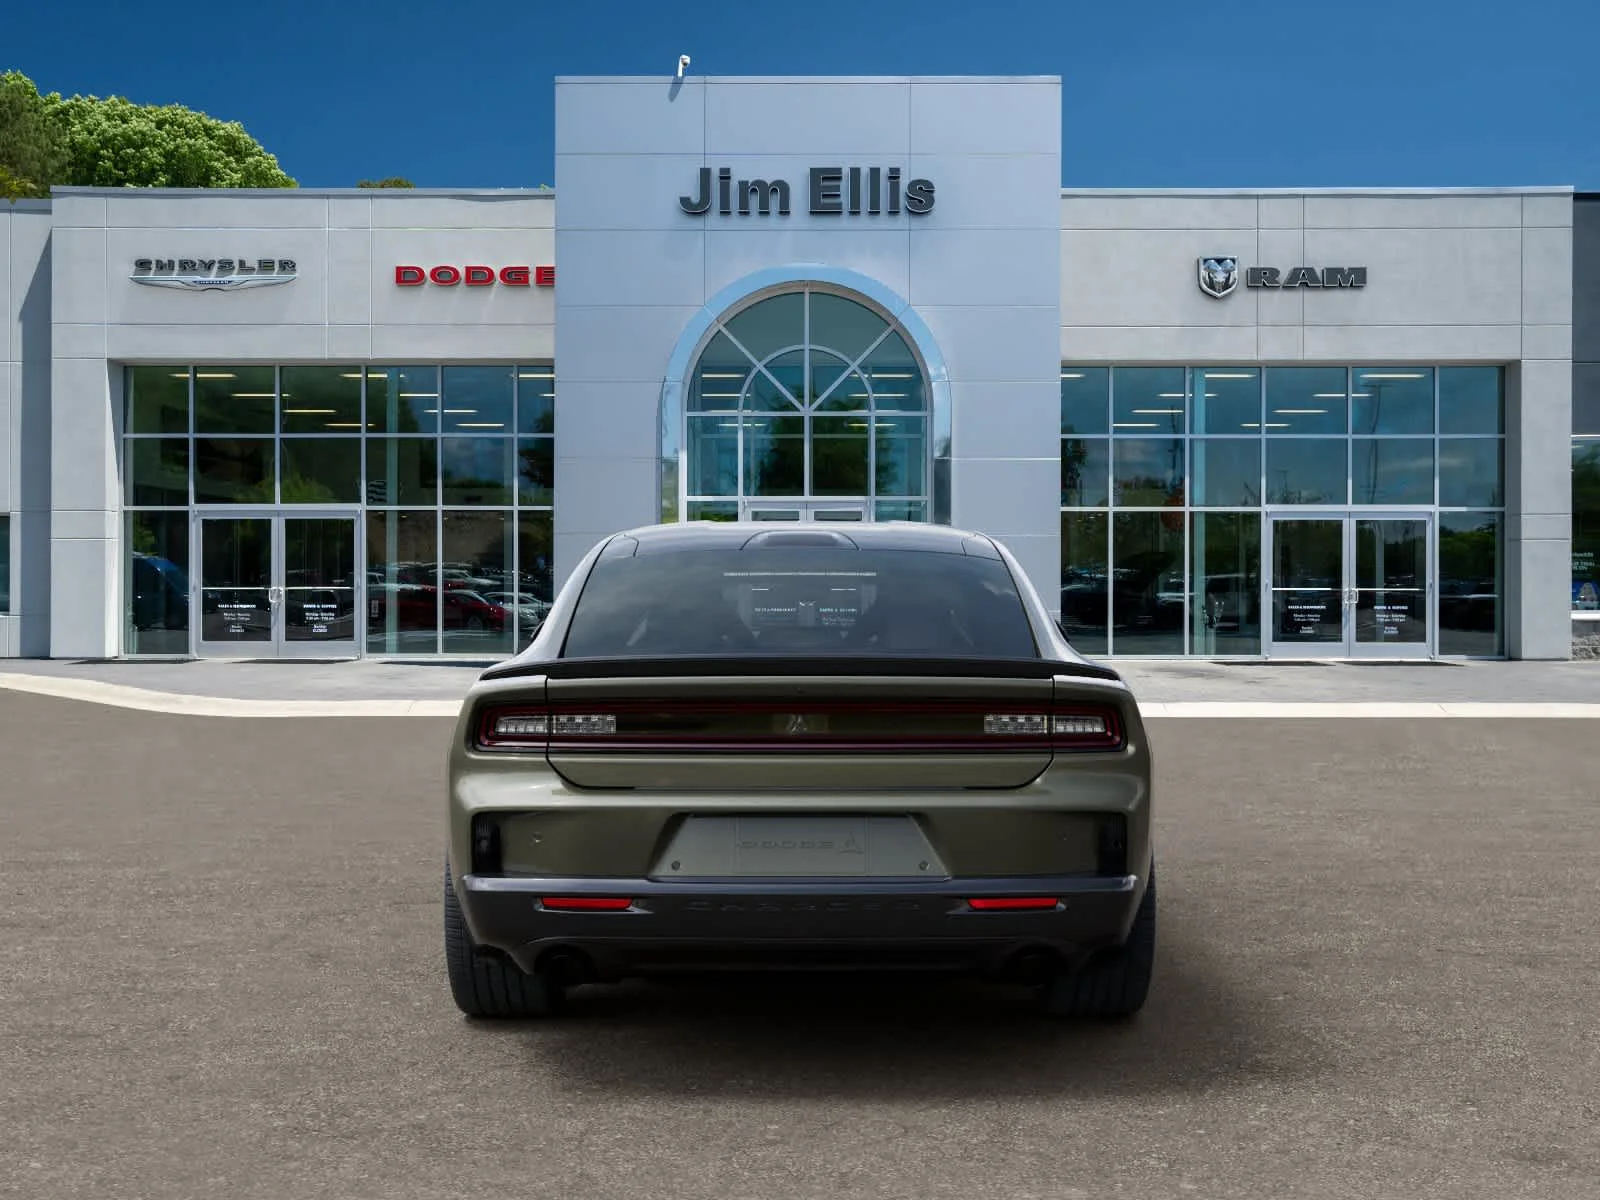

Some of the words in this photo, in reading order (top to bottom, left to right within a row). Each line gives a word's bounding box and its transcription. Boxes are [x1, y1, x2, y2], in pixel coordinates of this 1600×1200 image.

[679, 167, 791, 215] Jim
[808, 167, 936, 215] Ellis
[134, 258, 297, 272] CHRYSLER
[395, 265, 555, 287] DODGE
[1247, 266, 1368, 288] RAM
